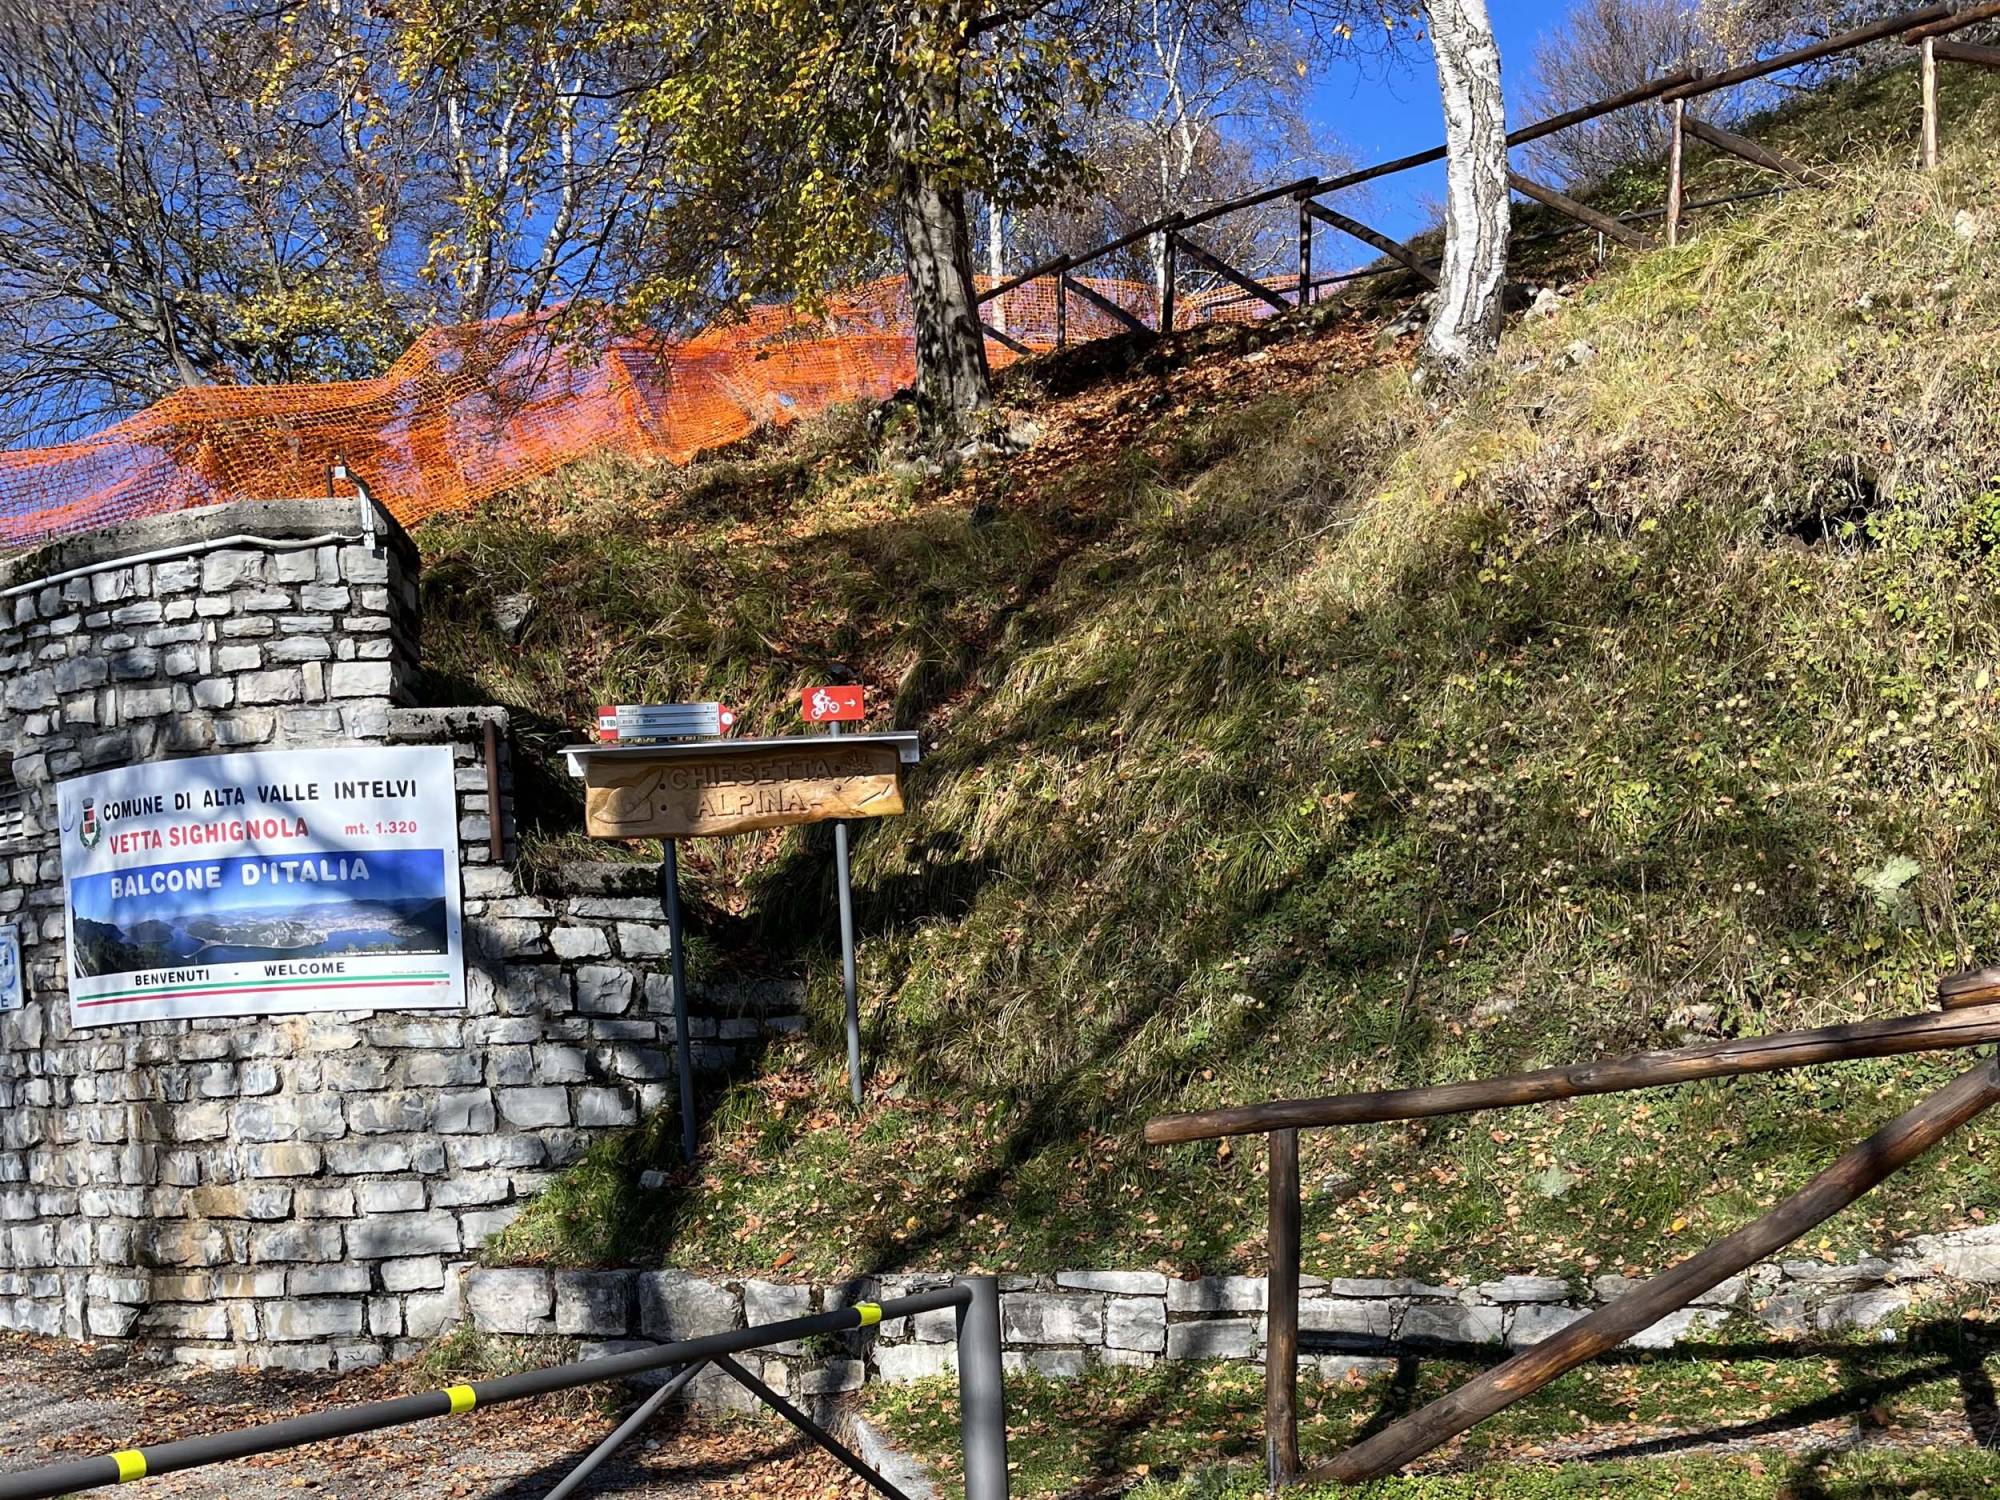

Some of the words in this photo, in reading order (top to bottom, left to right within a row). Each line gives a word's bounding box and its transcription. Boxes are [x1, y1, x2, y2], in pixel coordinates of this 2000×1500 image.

[670, 758, 834, 791] CHIESETTA
[103, 795, 164, 821] COMUNE
[174, 792, 191, 810] DI
[203, 787, 245, 808] ALTA
[257, 783, 319, 803] VALLE
[334, 779, 417, 799] INTELVI
[694, 788, 808, 818] ALPINA
[109, 829, 162, 855] VETTA
[169, 817, 309, 847] SIGHIGNOLA
[345, 825, 369, 835] mt.
[375, 821, 417, 834] 1.320
[111, 866, 222, 899] BALCONE
[241, 858, 370, 886] D'ITALIA
[135, 969, 209, 986] BENVENUTI
[264, 962, 345, 977] WELCOME
